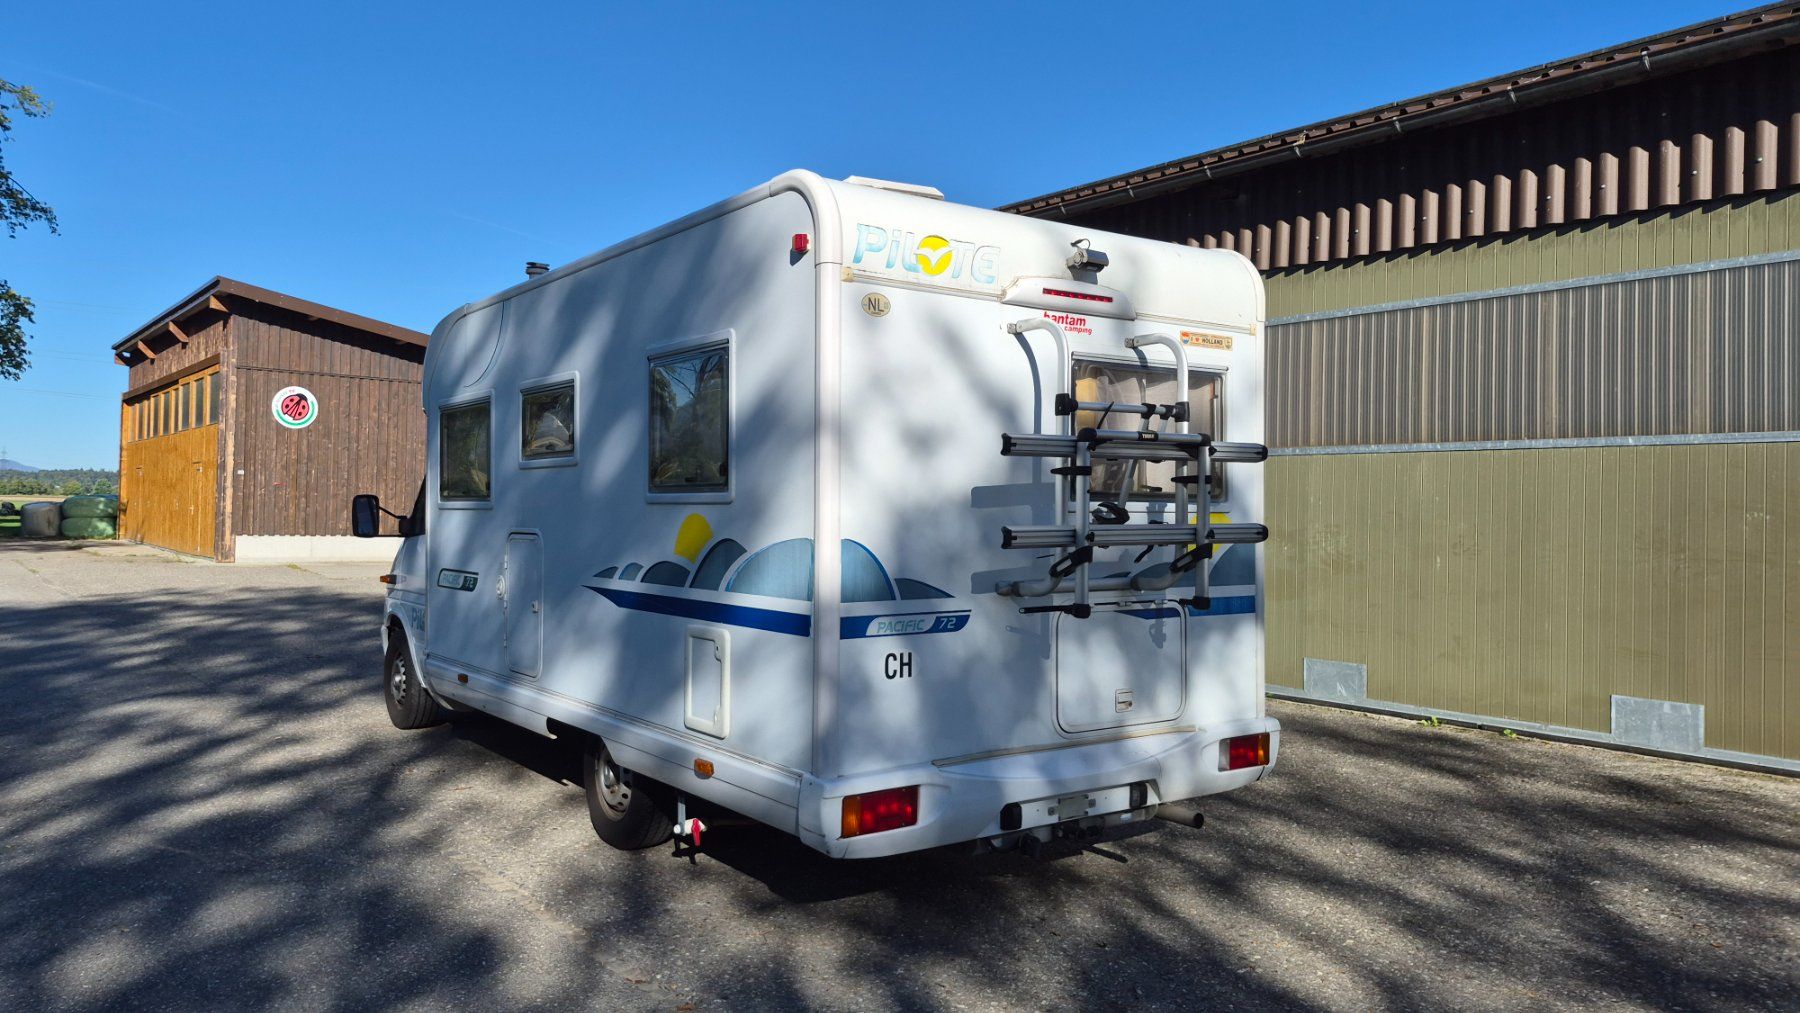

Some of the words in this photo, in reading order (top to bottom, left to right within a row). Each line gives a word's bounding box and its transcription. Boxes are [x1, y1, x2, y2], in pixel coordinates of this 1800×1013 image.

[868, 297, 885, 312] NL
[1064, 326, 1093, 336] camping
[939, 617, 957, 629] 72
[884, 652, 913, 680] CH
